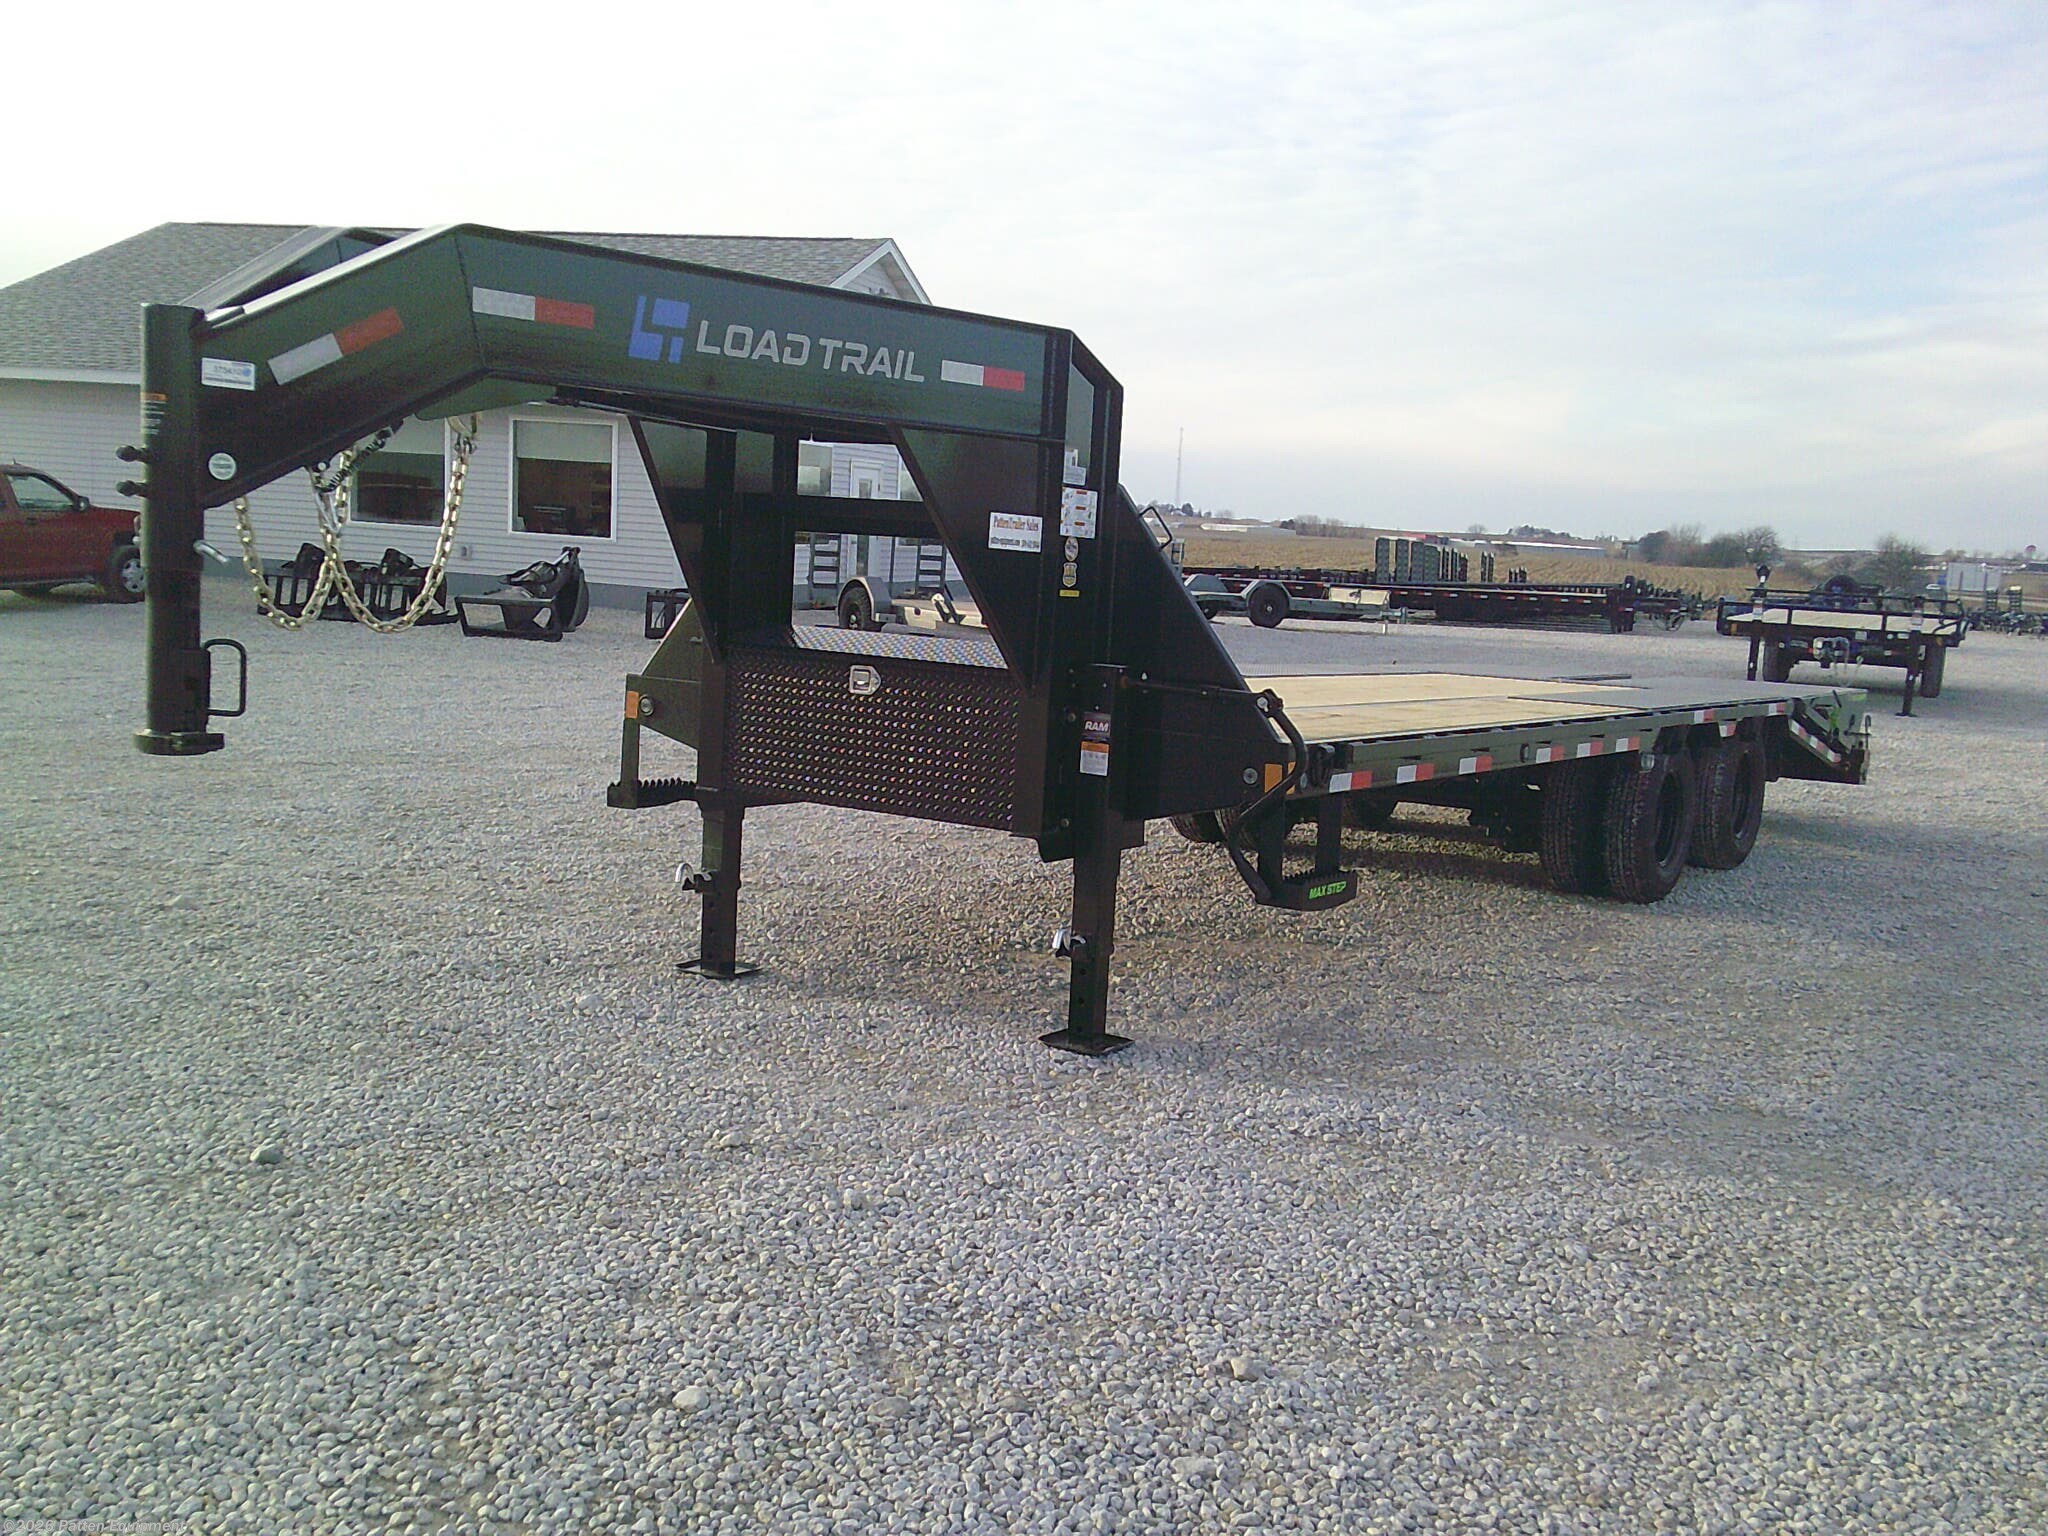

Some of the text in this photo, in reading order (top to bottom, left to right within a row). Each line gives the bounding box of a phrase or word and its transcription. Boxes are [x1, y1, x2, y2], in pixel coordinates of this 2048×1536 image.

[696, 320, 925, 383] LOAD TRAIL
[1084, 721, 1109, 732] RAM
[1309, 881, 1347, 899] MAX STEP
